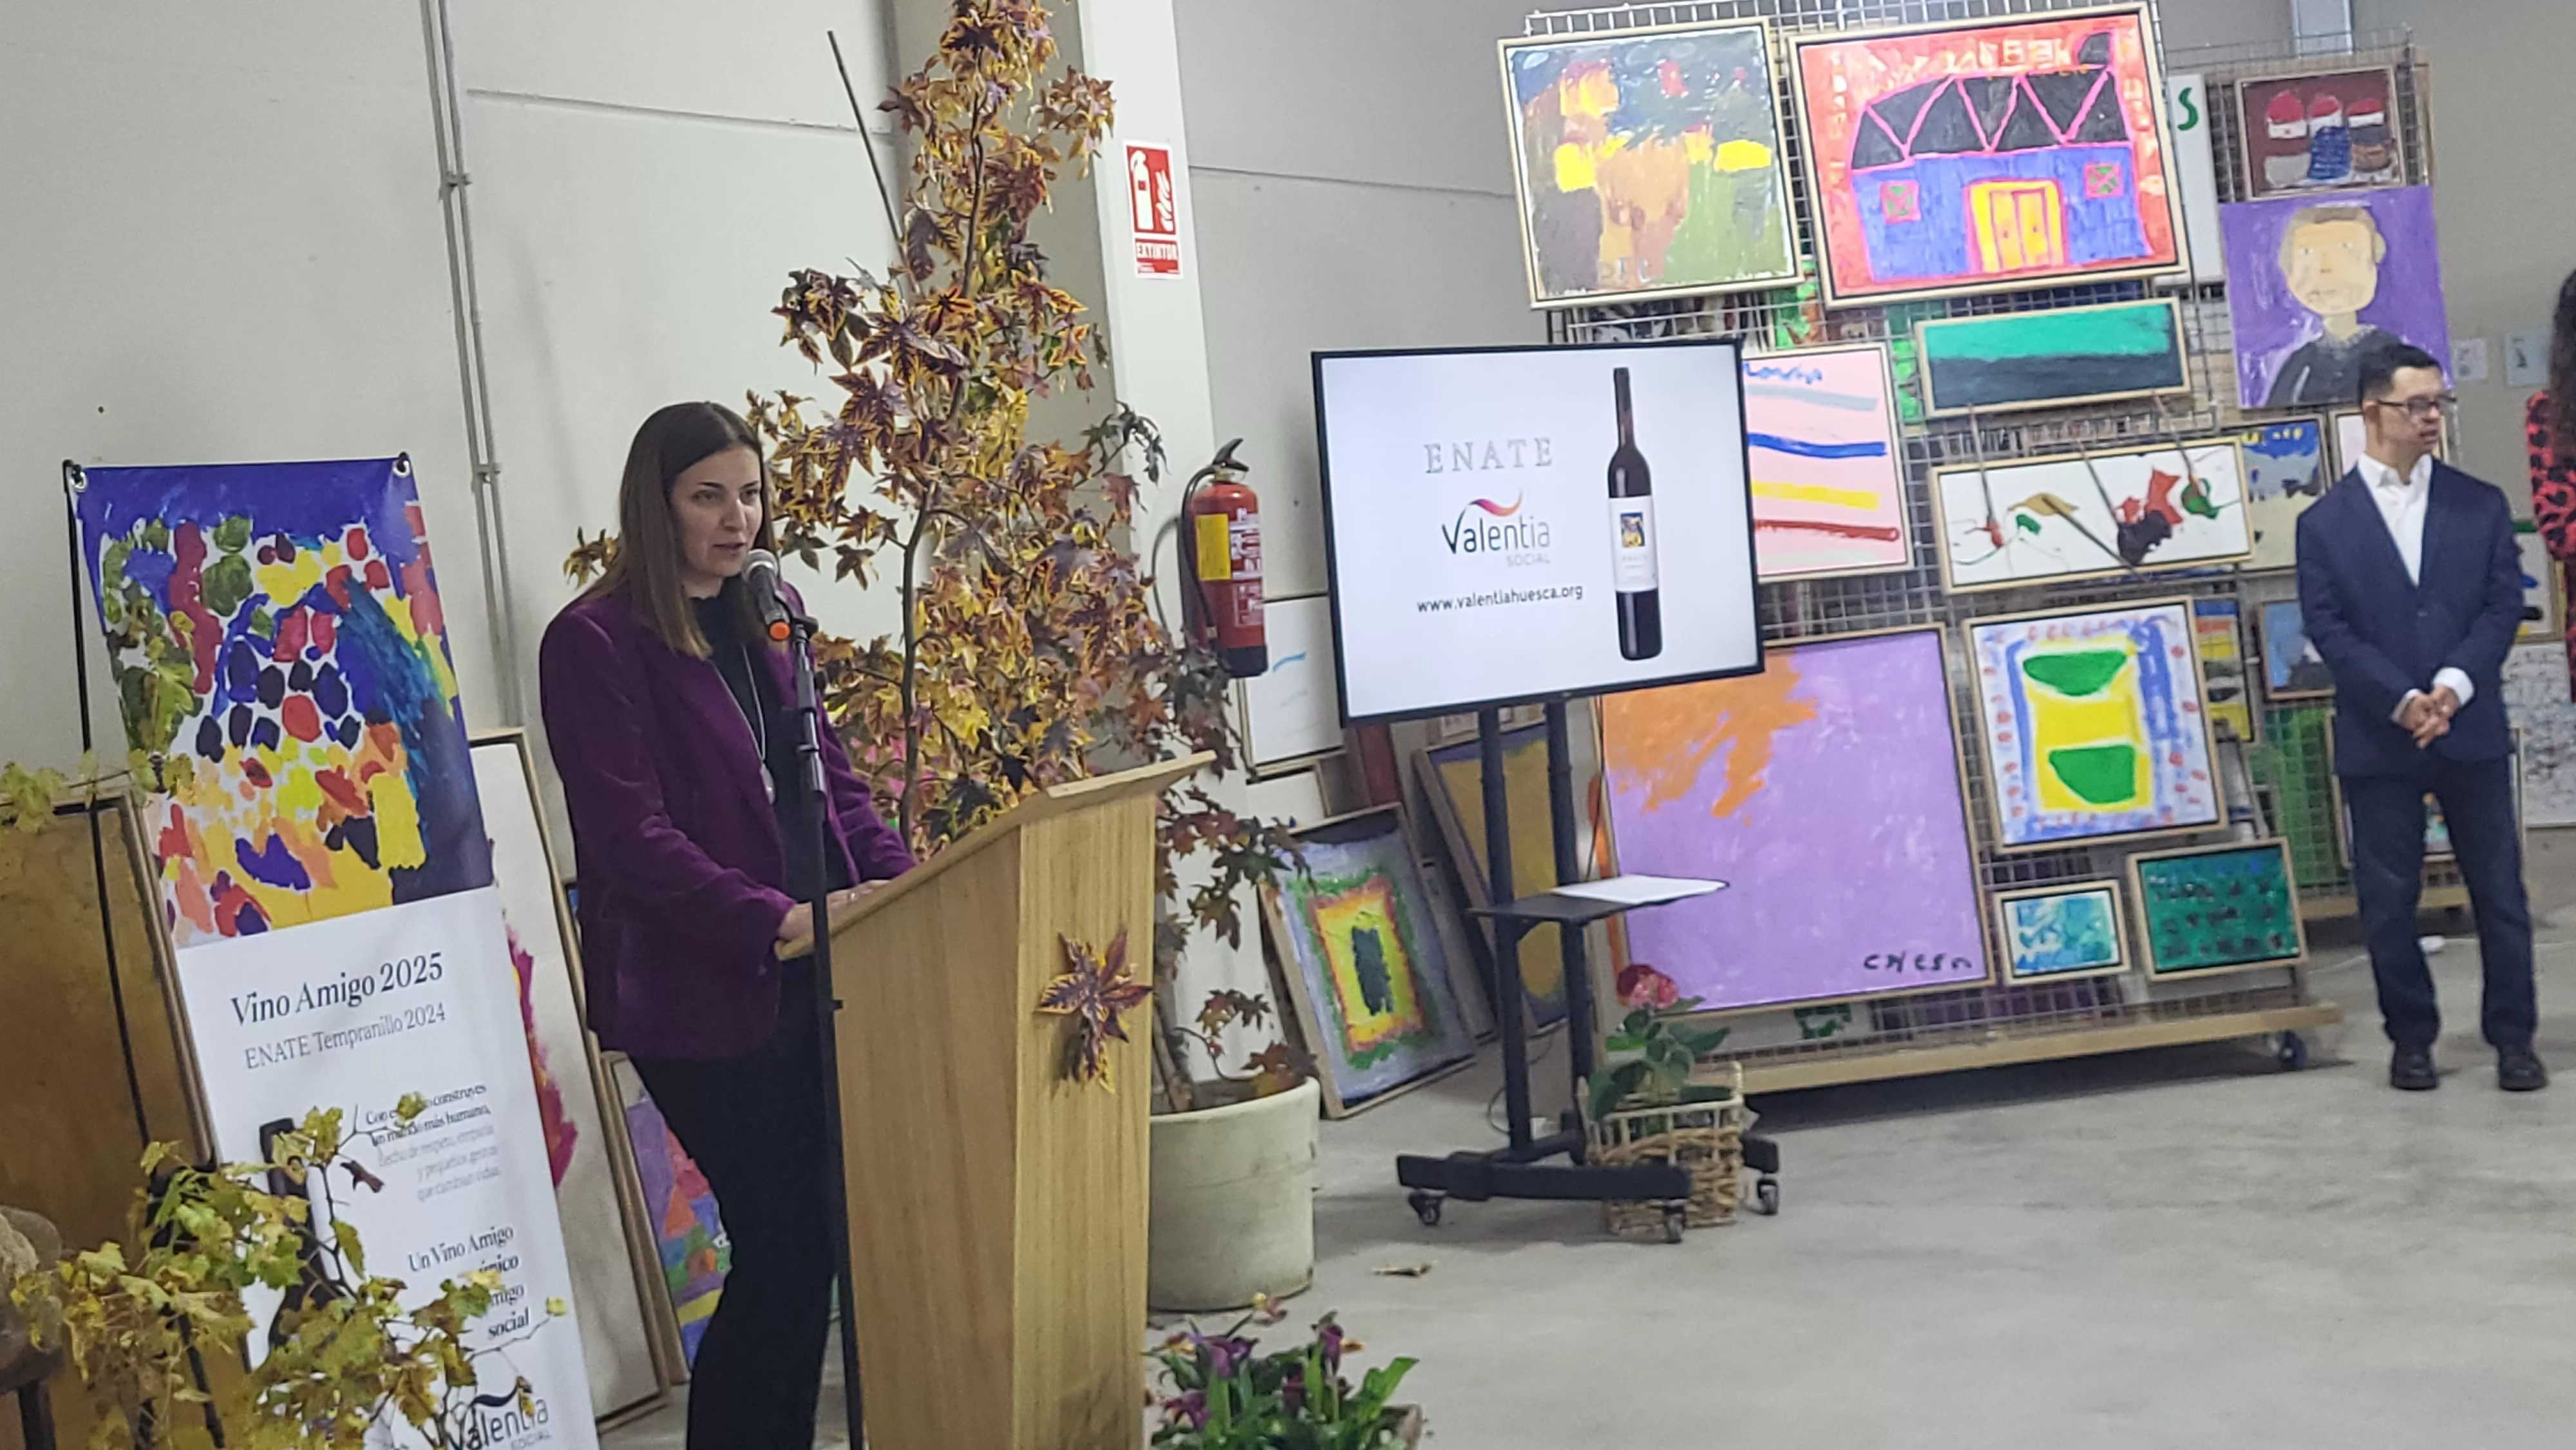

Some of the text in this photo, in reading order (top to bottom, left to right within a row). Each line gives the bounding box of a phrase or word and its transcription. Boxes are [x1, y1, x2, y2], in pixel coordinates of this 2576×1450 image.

[1423, 437, 1552, 475] ENATE
[1441, 506, 1551, 555] Valentia
[1506, 552, 1551, 568] SOCIAL
[1416, 584, 1584, 613] www.valentiahuesca.org
[231, 951, 443, 1026] Vino Amigo 2025
[244, 1001, 446, 1070] ENATE Tempranillo 2024
[408, 1226, 514, 1273] Un Vino Amigo
[489, 1284, 525, 1306] migo
[488, 1306, 529, 1339] social
